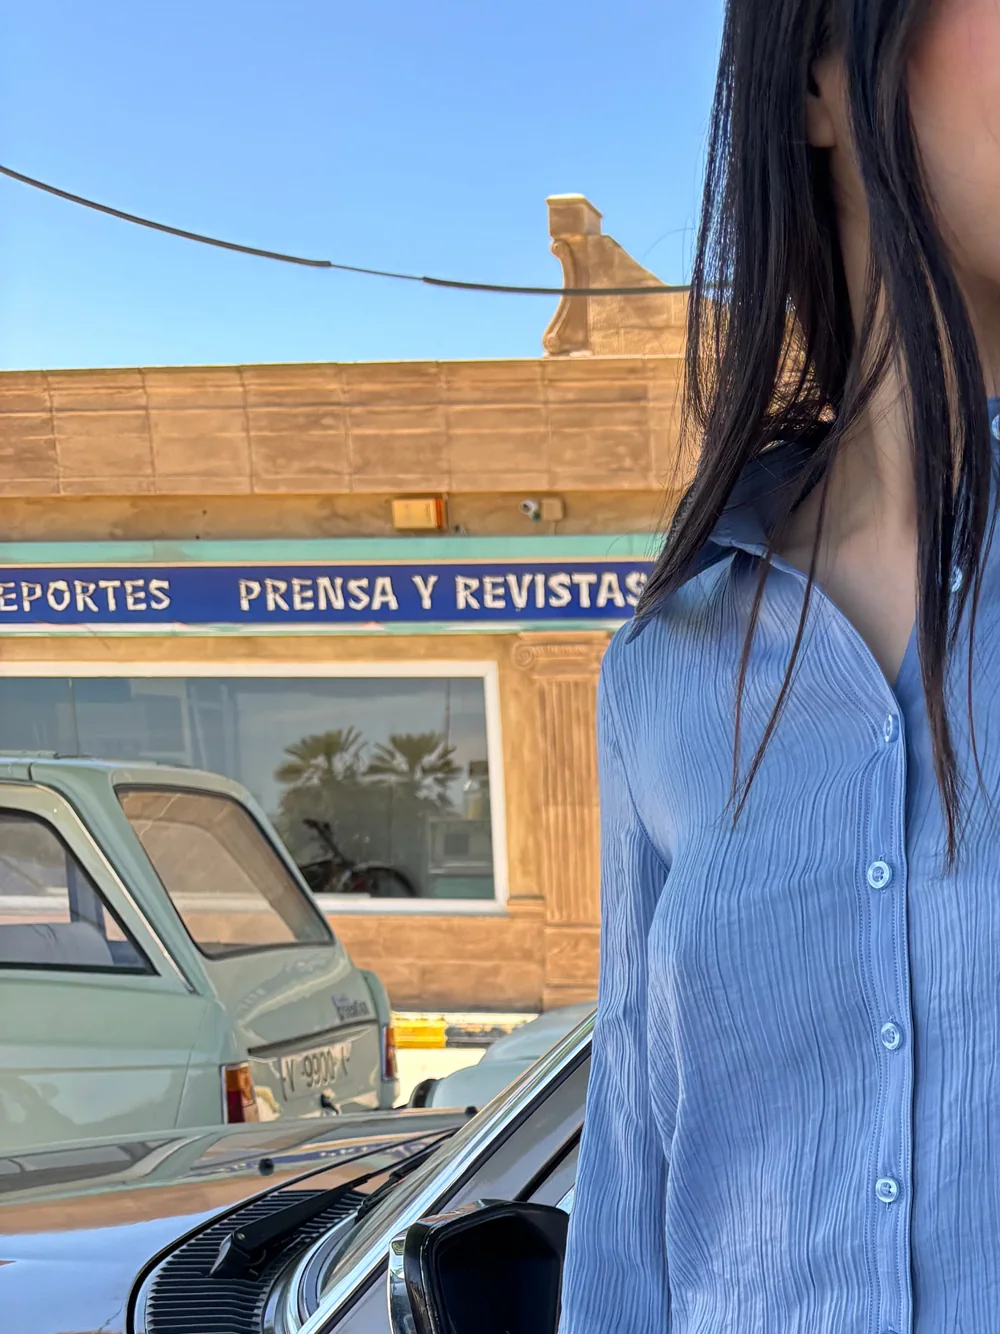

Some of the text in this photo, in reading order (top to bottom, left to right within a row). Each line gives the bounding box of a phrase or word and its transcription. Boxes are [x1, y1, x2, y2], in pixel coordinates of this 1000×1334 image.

[238, 571, 649, 612] PRENSA Y REVISTAS
